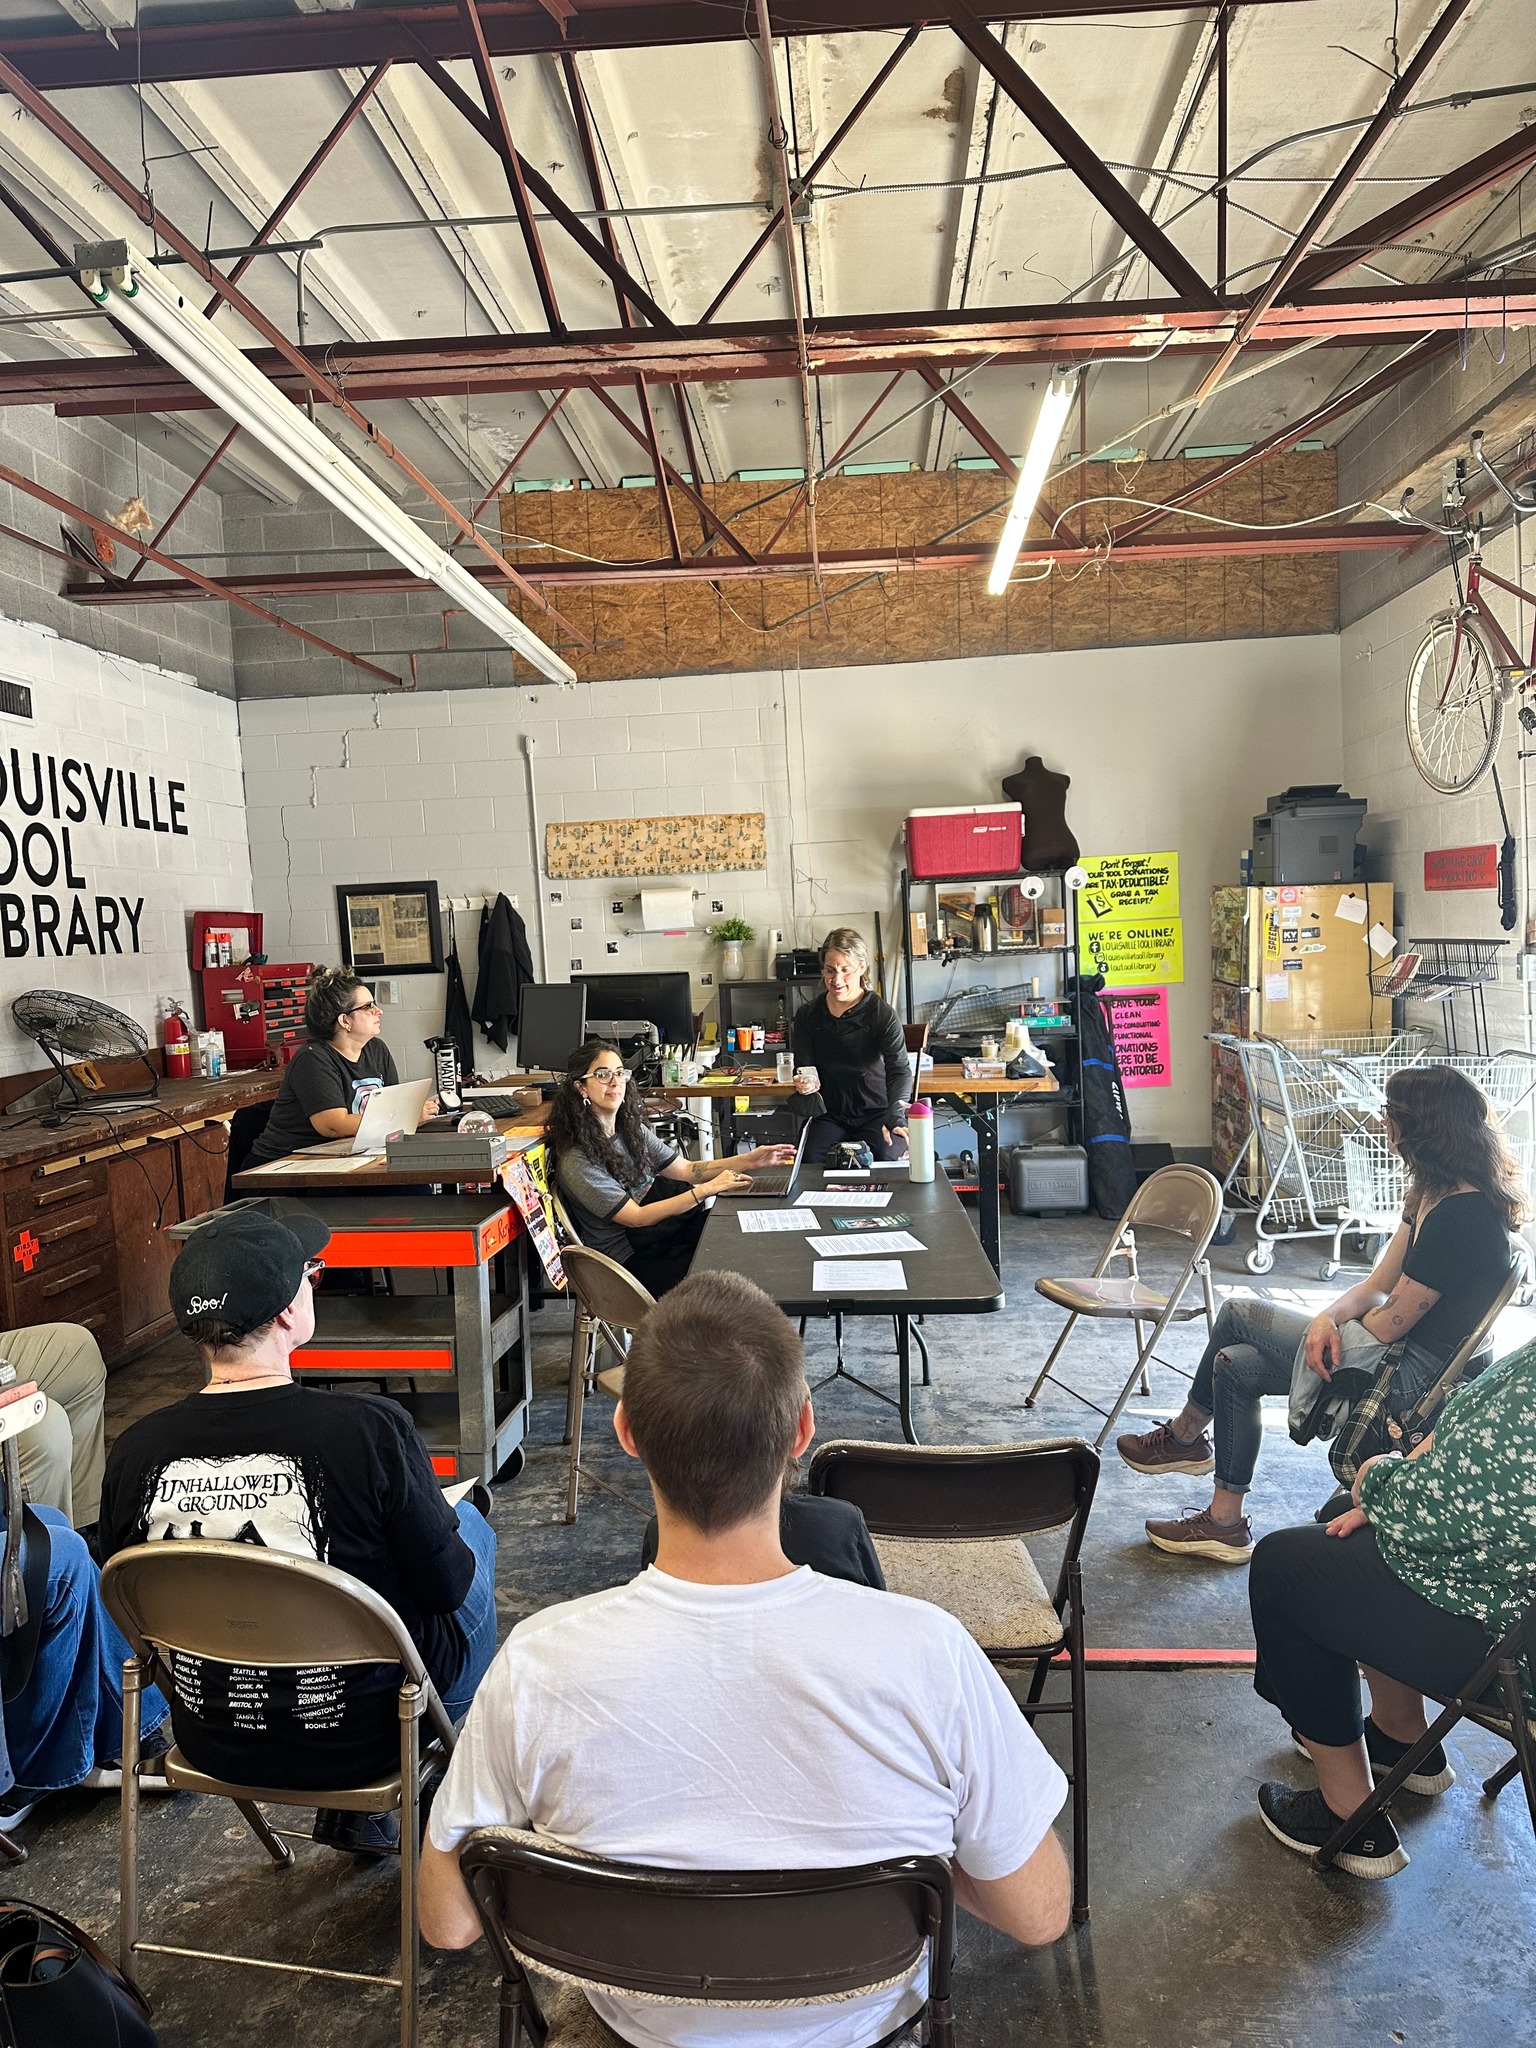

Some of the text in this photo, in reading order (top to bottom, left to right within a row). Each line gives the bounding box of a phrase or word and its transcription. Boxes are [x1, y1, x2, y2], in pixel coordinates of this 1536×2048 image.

[1121, 857, 1151, 870] Forget!
[1467, 852, 1487, 867] CART
[1106, 870, 1122, 878] TOOL
[1124, 867, 1169, 876] DONATIONS
[1110, 890, 1132, 898] GRAB
[1118, 897, 1153, 906] RECEIPT!
[0, 892, 145, 958] BRARY
[1088, 928, 1174, 941] WE'RE ONLINE!
[1283, 931, 1298, 939] KY
[1111, 1000, 1132, 1009] EAVE
[1115, 1011, 1141, 1019] CLEAN
[1115, 1042, 1158, 1053] ONATIONS
[1117, 1053, 1158, 1065] ERE TO BE
[1120, 1064, 1164, 1077] VENTORIED
[441, 1060, 455, 1094] MAYDA
[17, 1241, 34, 1251] FIRST
[22, 1249, 32, 1258] AID
[186, 1292, 228, 1315] Boo!
[160, 1473, 293, 1502] UNHALLOWED
[177, 1493, 268, 1515] GROUNDS
[194, 1658, 202, 1666] NC
[233, 1667, 256, 1676] SEATTLE,
[300, 1675, 330, 1684] CHICAGO,
